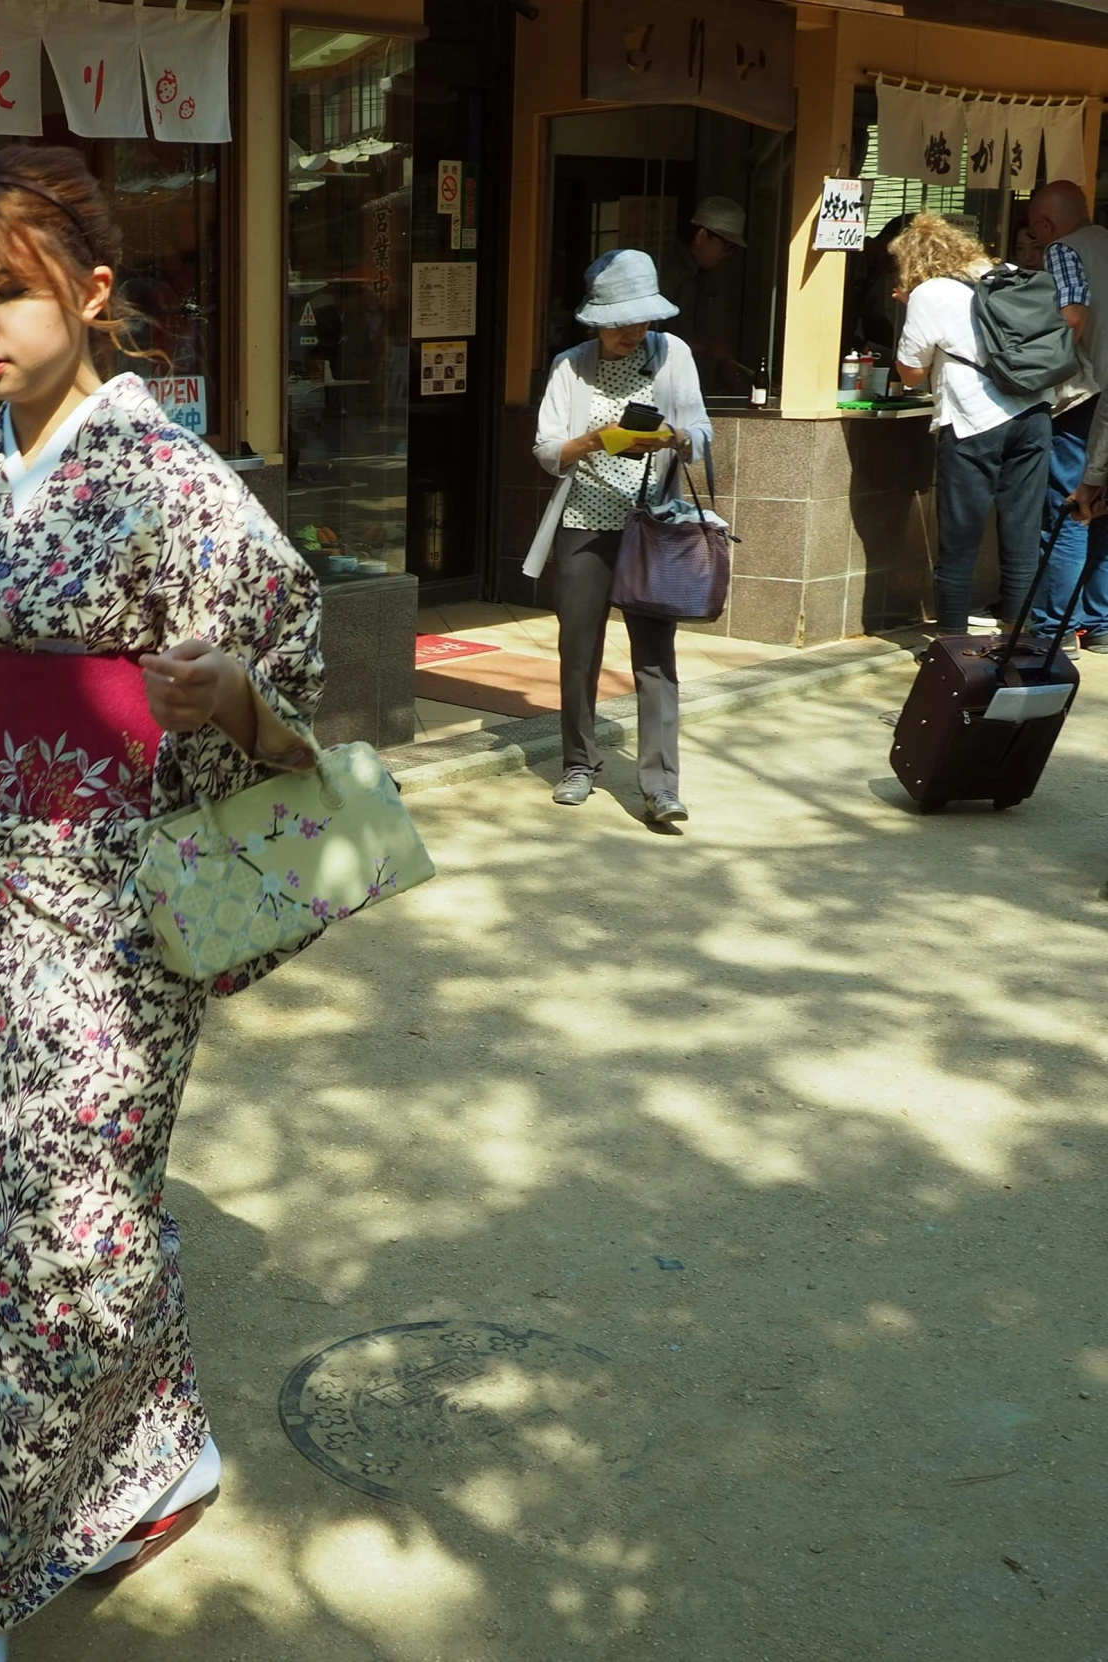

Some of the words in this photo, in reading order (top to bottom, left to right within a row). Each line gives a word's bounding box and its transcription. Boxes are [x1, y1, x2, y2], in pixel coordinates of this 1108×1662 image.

[372, 198, 393, 299] 営業中
[147, 378, 199, 404] OPEN
[169, 408, 202, 432] 業中
